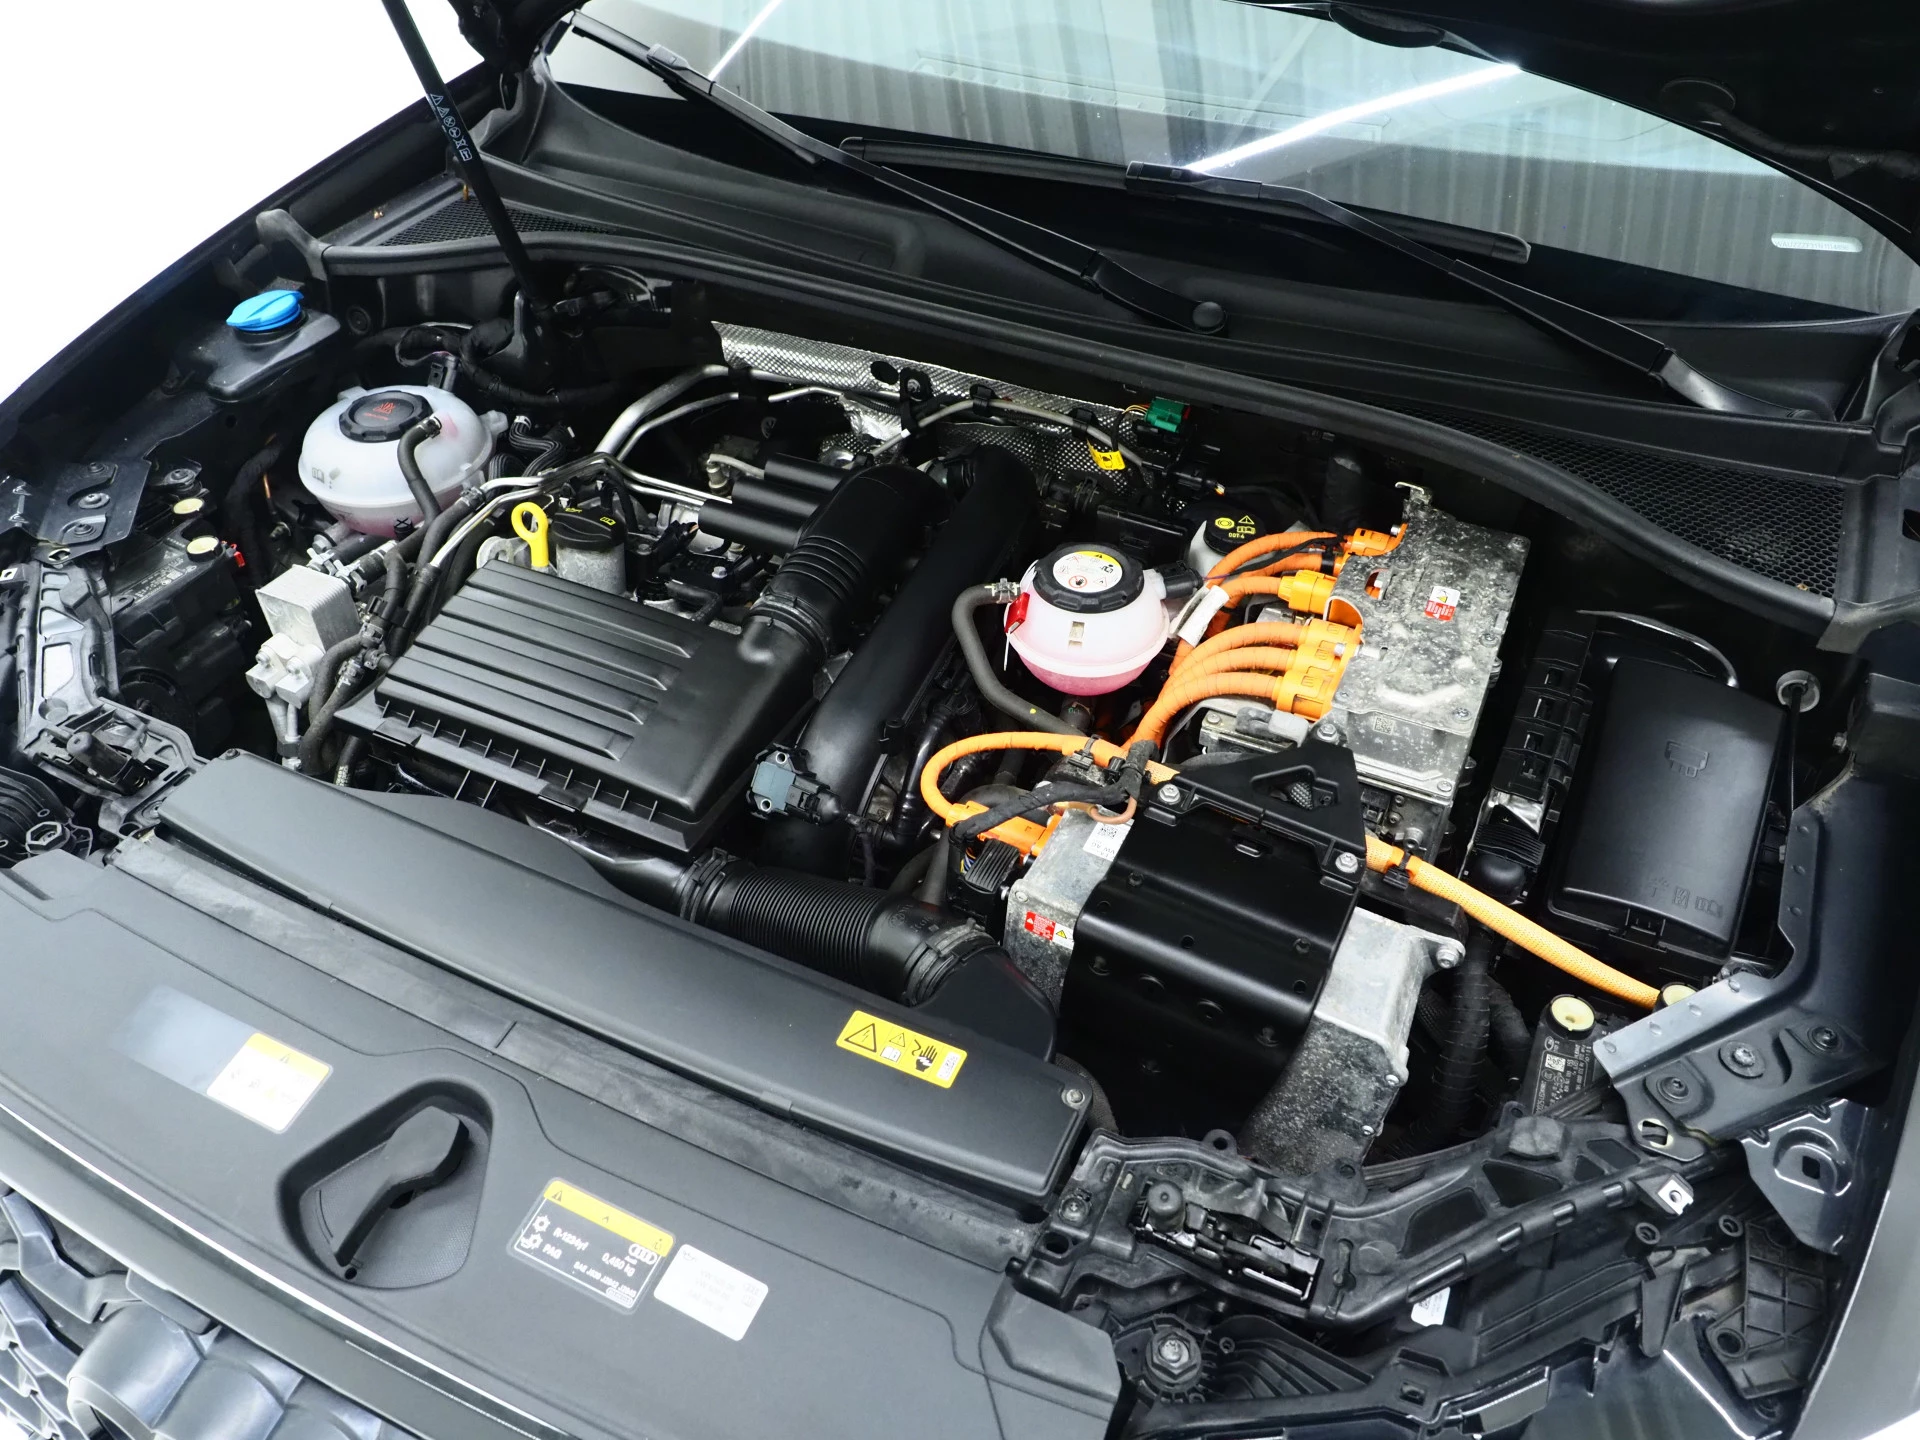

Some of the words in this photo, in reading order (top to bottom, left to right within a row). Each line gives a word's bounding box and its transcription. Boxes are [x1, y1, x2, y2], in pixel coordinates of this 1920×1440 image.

[542, 1243, 562, 1260] PAG
[602, 1252, 625, 1270] 0,450
[623, 1263, 636, 1277] kg
